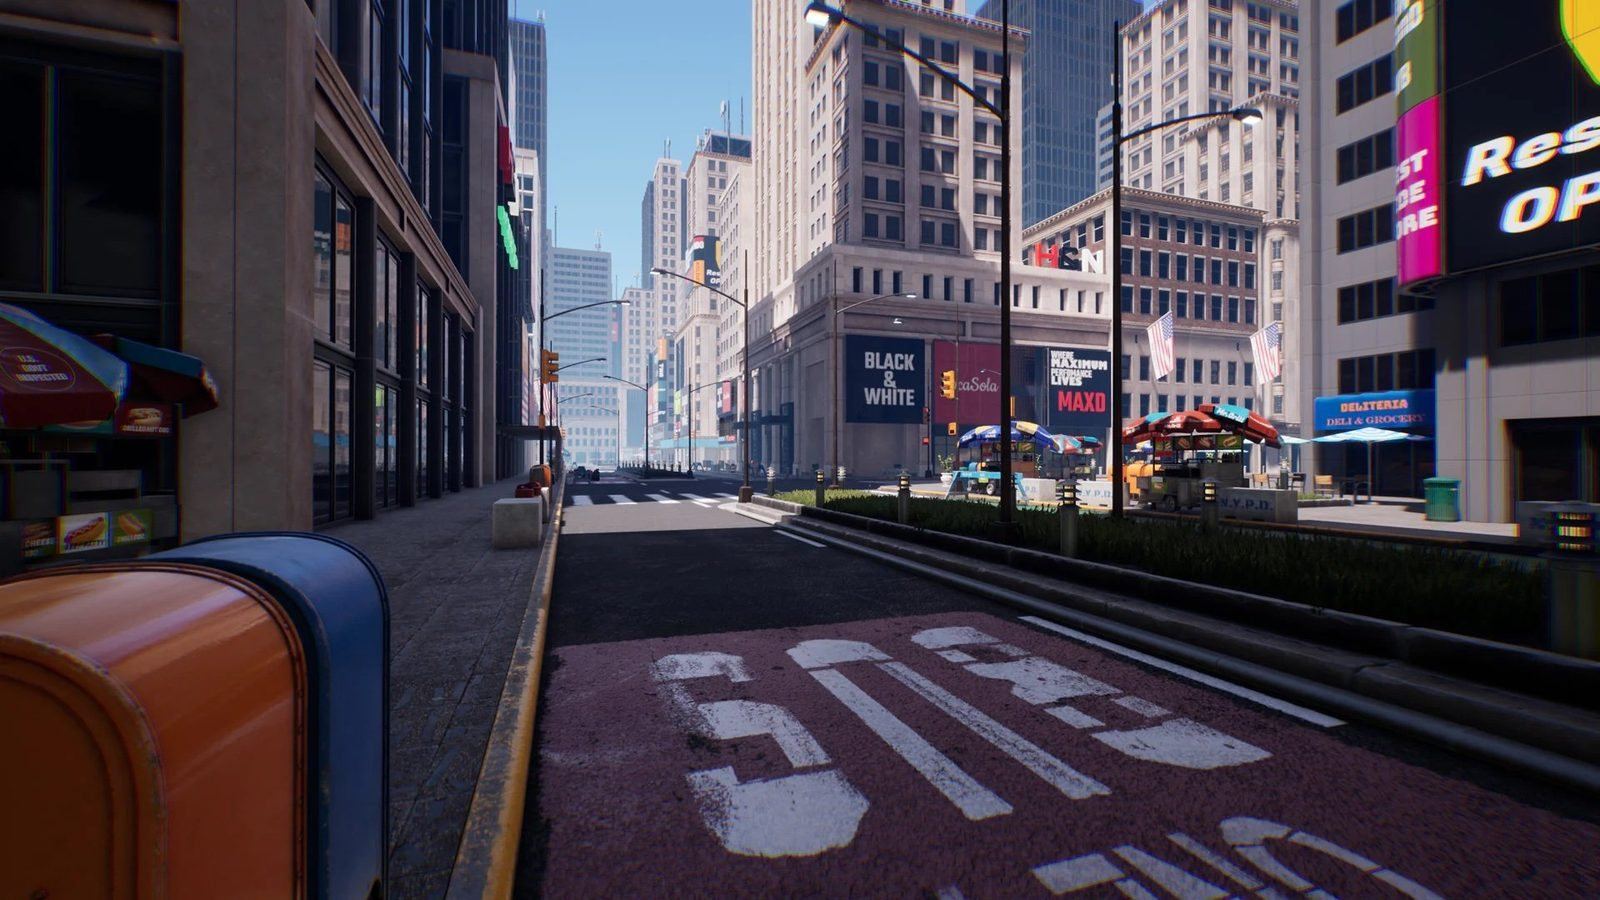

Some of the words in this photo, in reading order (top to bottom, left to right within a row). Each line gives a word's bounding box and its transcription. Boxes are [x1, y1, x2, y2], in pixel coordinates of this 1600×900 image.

[864, 352, 915, 371] BLACK
[1050, 350, 1074, 360] WHERE
[1050, 358, 1107, 371] MAXIMUM
[883, 371, 896, 388] &
[1050, 376, 1082, 386] LIVES
[864, 388, 915, 406] WHITE
[1340, 399, 1408, 413] DELITERIA
[1326, 417, 1352, 426] DELI
[1354, 417, 1364, 426] &
[1365, 414, 1425, 425] GROCERY
